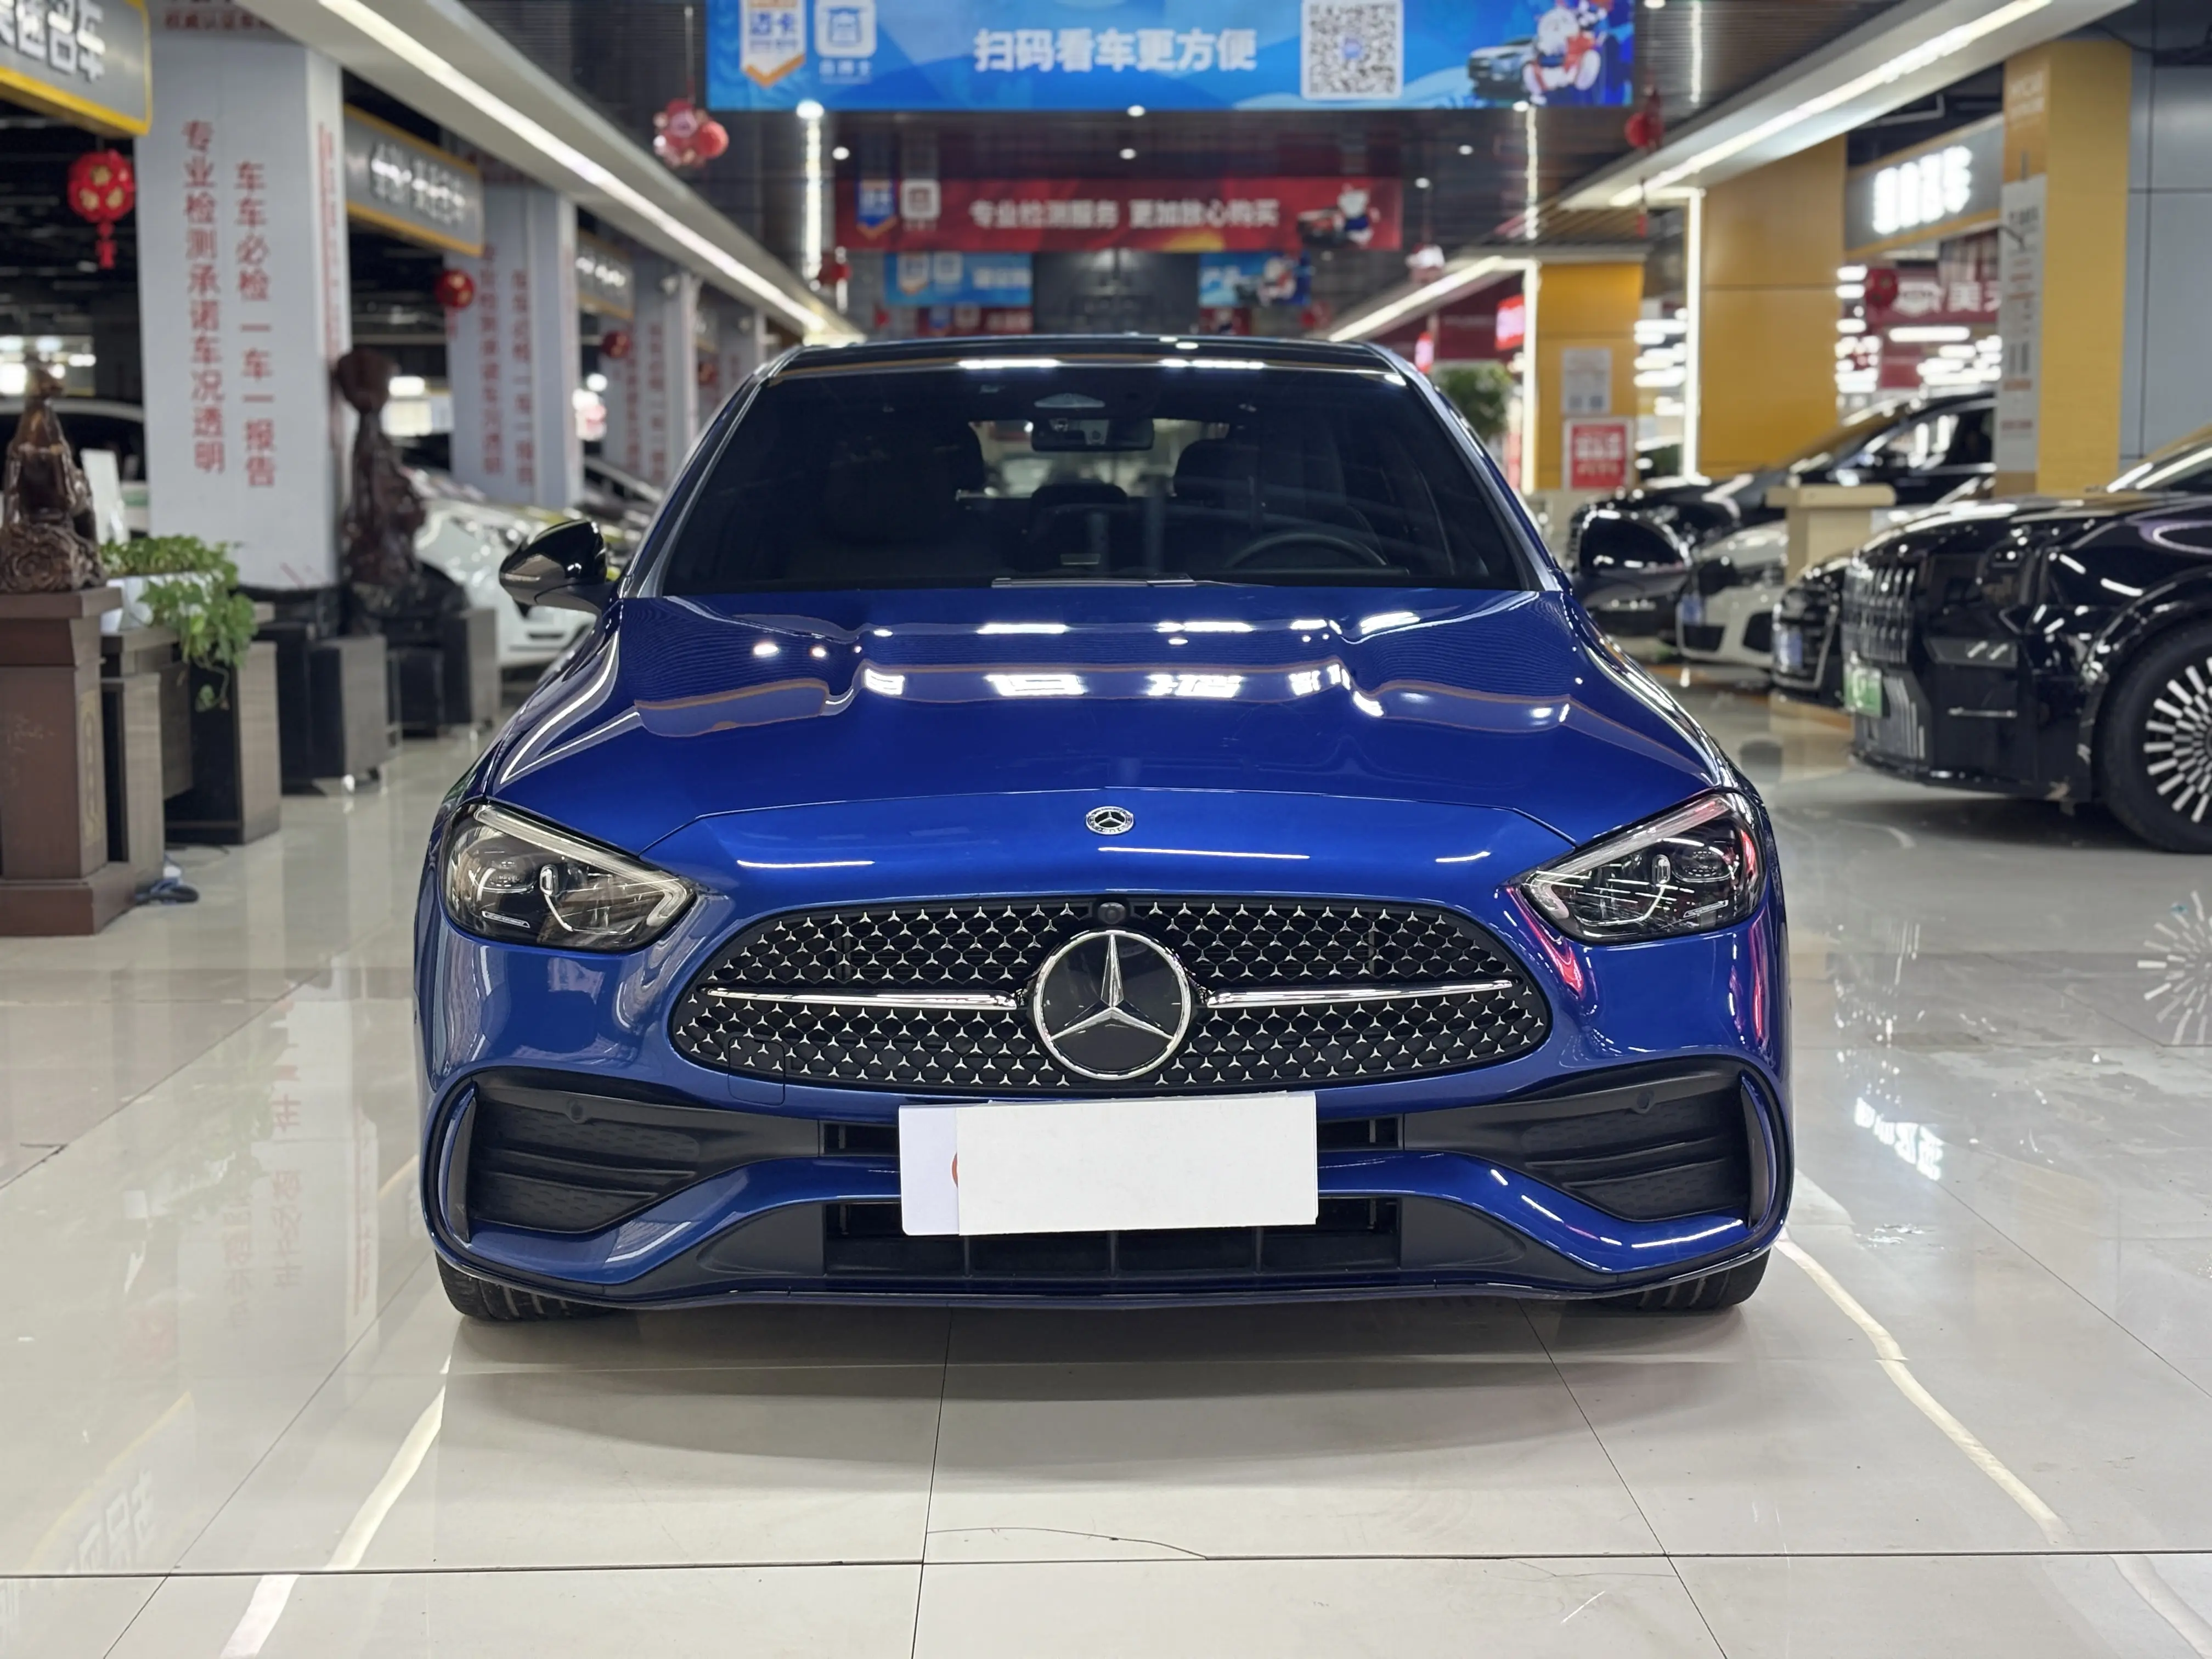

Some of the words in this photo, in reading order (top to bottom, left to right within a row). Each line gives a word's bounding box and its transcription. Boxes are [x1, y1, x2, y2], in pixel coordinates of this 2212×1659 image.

[974, 28, 1258, 72] 扫码看车更方便
[182, 119, 225, 475] 专业检测承诺车况透明
[235, 161, 275, 488] 车车必检一车一报告
